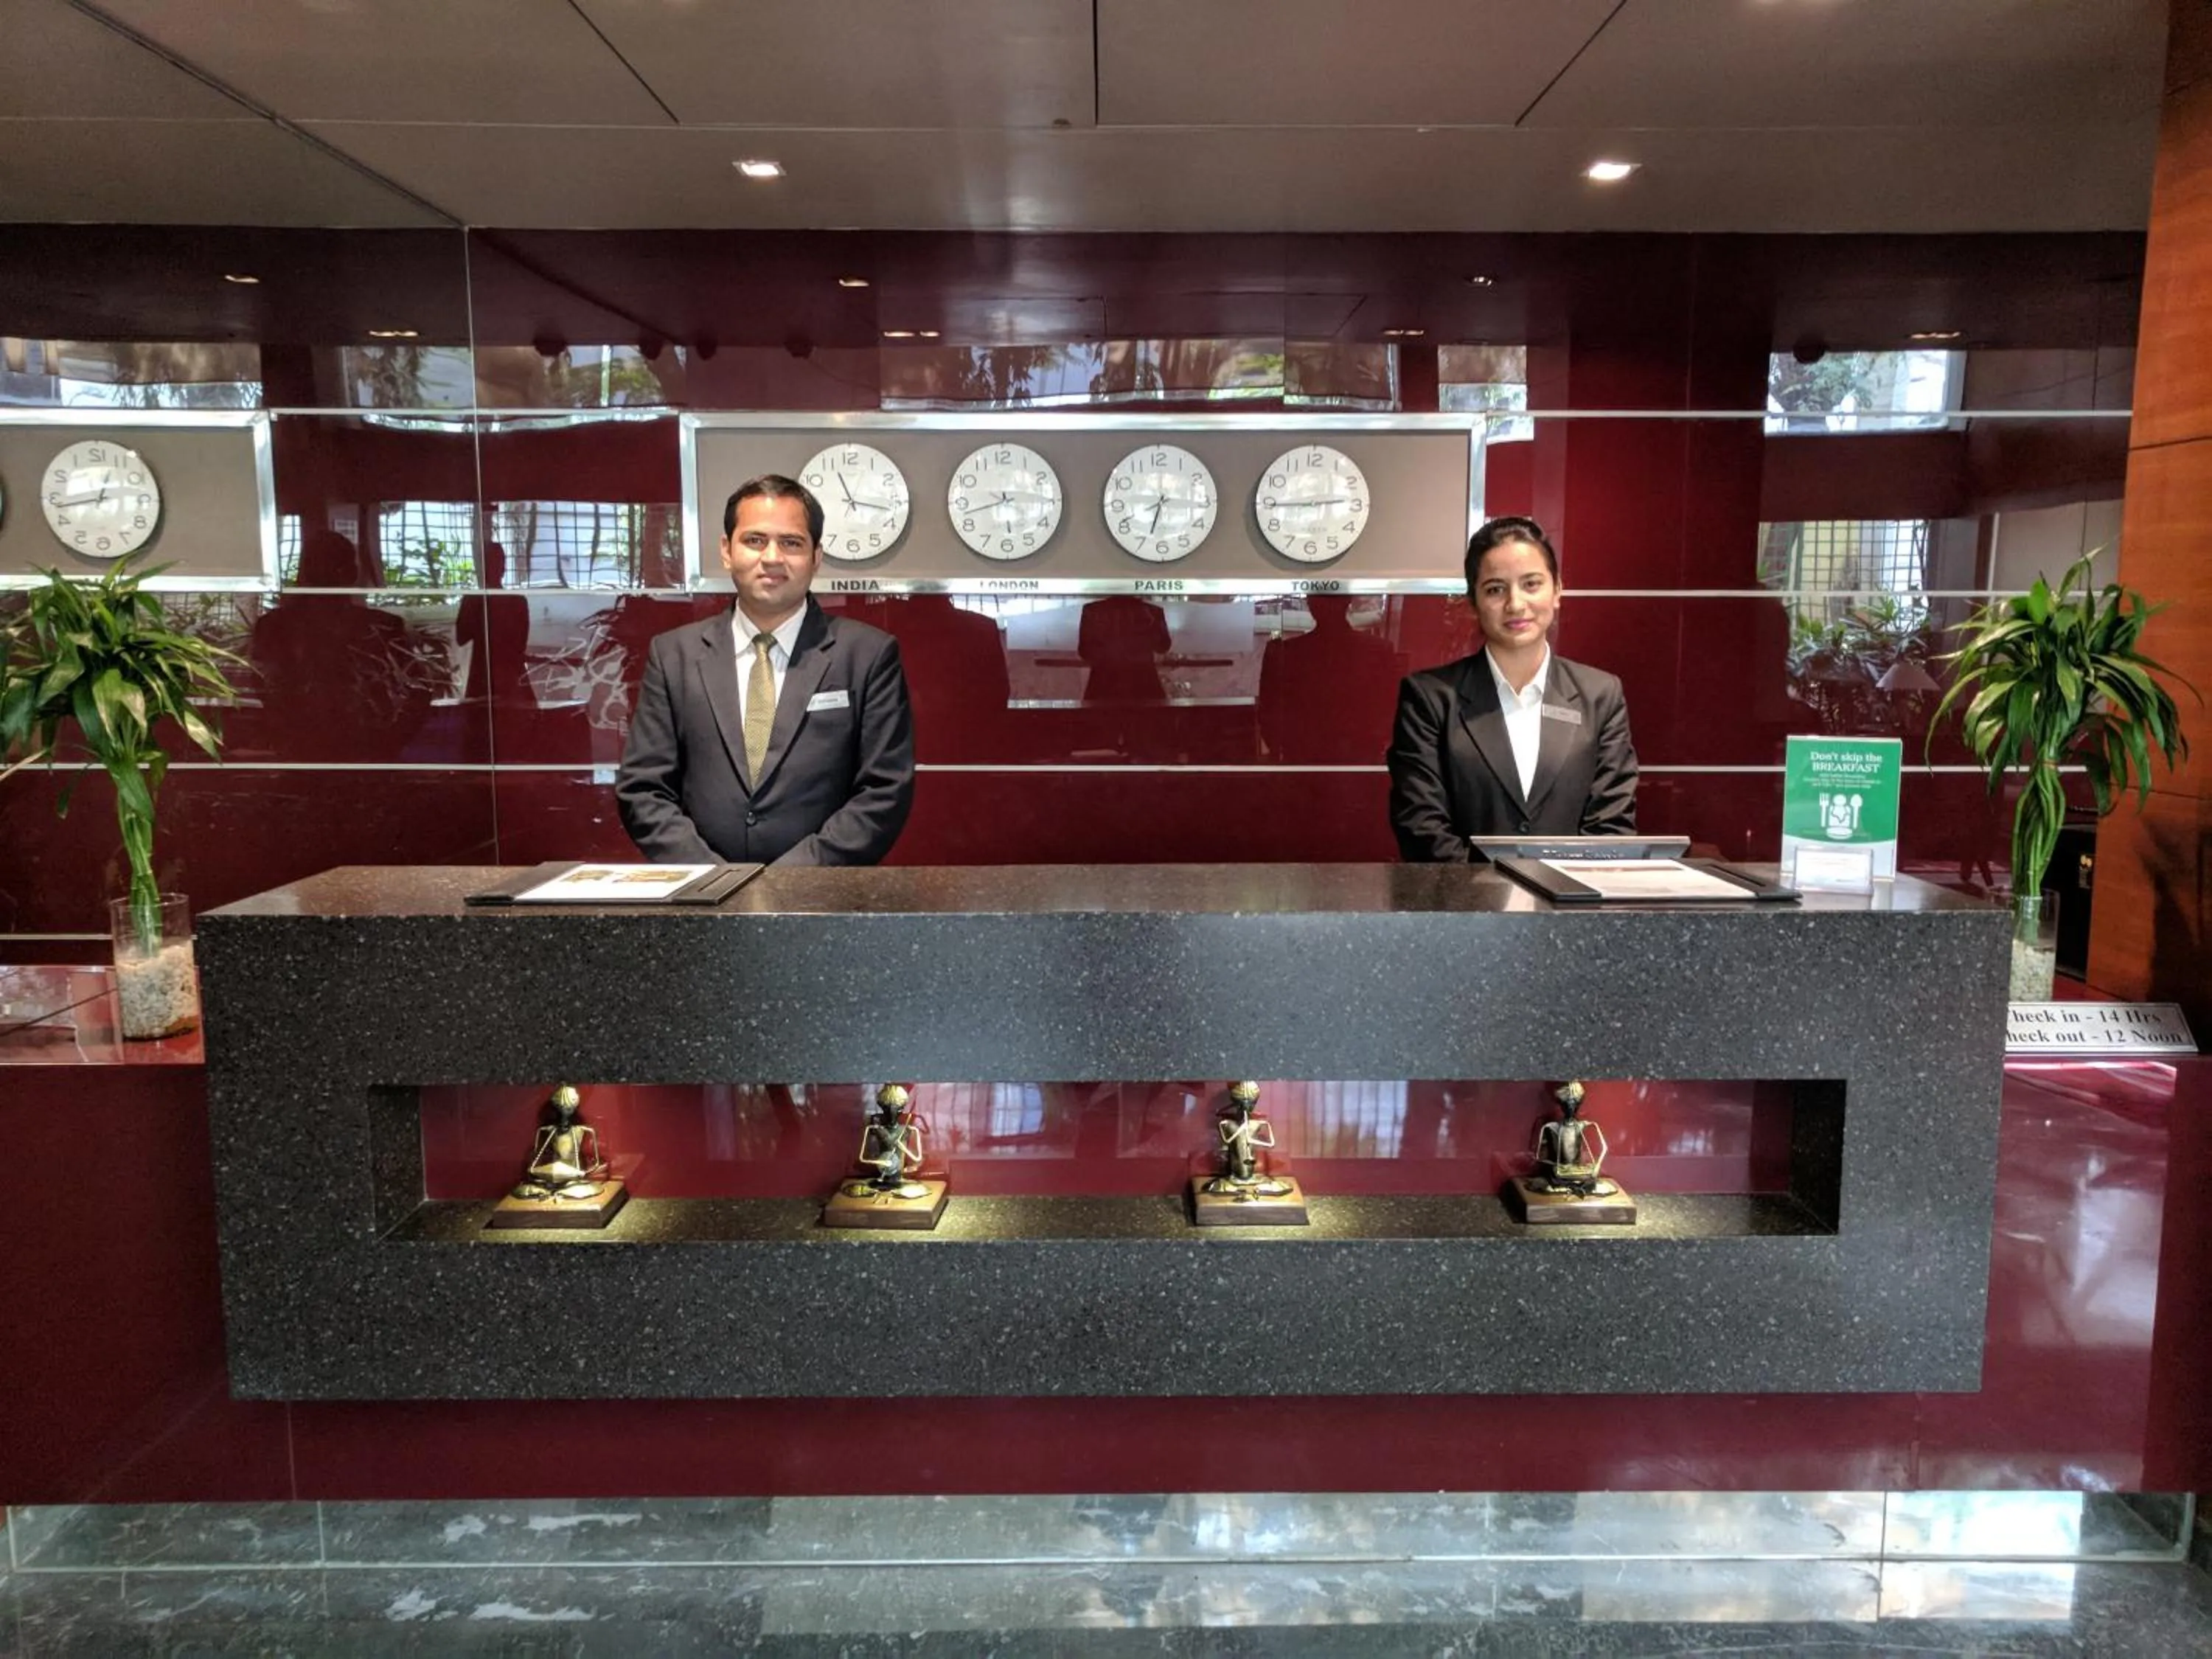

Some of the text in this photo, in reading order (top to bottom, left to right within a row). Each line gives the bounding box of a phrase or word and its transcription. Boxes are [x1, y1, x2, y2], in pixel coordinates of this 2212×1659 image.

[822, 456, 835, 471] 11
[842, 452, 859, 465] 12
[975, 457, 987, 471] 11
[995, 451, 1012, 465] 12
[1151, 453, 1167, 467] 12
[1307, 453, 1324, 467] 12
[1131, 459, 1143, 473] 11
[1287, 459, 1298, 473] 11
[806, 474, 824, 487] 10
[883, 473, 894, 486] 2
[959, 474, 977, 488] 10
[1036, 471, 1047, 485] 2
[1115, 476, 1133, 490] 10
[1192, 473, 1203, 487] 2
[1269, 475, 1286, 488] 10
[1345, 476, 1357, 490] 2
[956, 496, 969, 510] 9
[1111, 499, 1124, 512] 9
[1263, 496, 1276, 509] 9
[1349, 498, 1363, 512] 3
[883, 518, 897, 529] 4
[962, 518, 975, 532] 8
[1037, 516, 1049, 528] 4
[1119, 521, 1130, 535] 8
[1192, 518, 1205, 529] 4
[1267, 518, 1281, 532] 8
[1342, 521, 1356, 533] 4
[826, 533, 838, 548] 7
[846, 539, 860, 553] 6
[869, 533, 881, 547] 5
[979, 534, 991, 548] 7
[1001, 539, 1014, 552] 6
[1023, 532, 1034, 546] 5
[1135, 536, 1147, 552] 7
[1178, 534, 1190, 548] 5
[1284, 535, 1295, 549] 7
[1326, 536, 1338, 549] 5
[1155, 540, 1169, 554] 6
[1304, 541, 1318, 555] 6
[831, 580, 880, 591] INDIA
[1135, 580, 1183, 591] PARIS
[1291, 580, 1340, 591] TOKYO
[1810, 751, 1882, 764] Don't skip the
[1812, 762, 1880, 773] BREAKFAST
[2008, 1009, 2056, 1023] heck
[2060, 1009, 2080, 1022] in
[2100, 1009, 2119, 1023] 14
[2006, 1029, 2051, 1043] heck
[2055, 1030, 2087, 1042] out
[2105, 1030, 2126, 1042] 12
[2130, 1029, 2183, 1043] Noon
